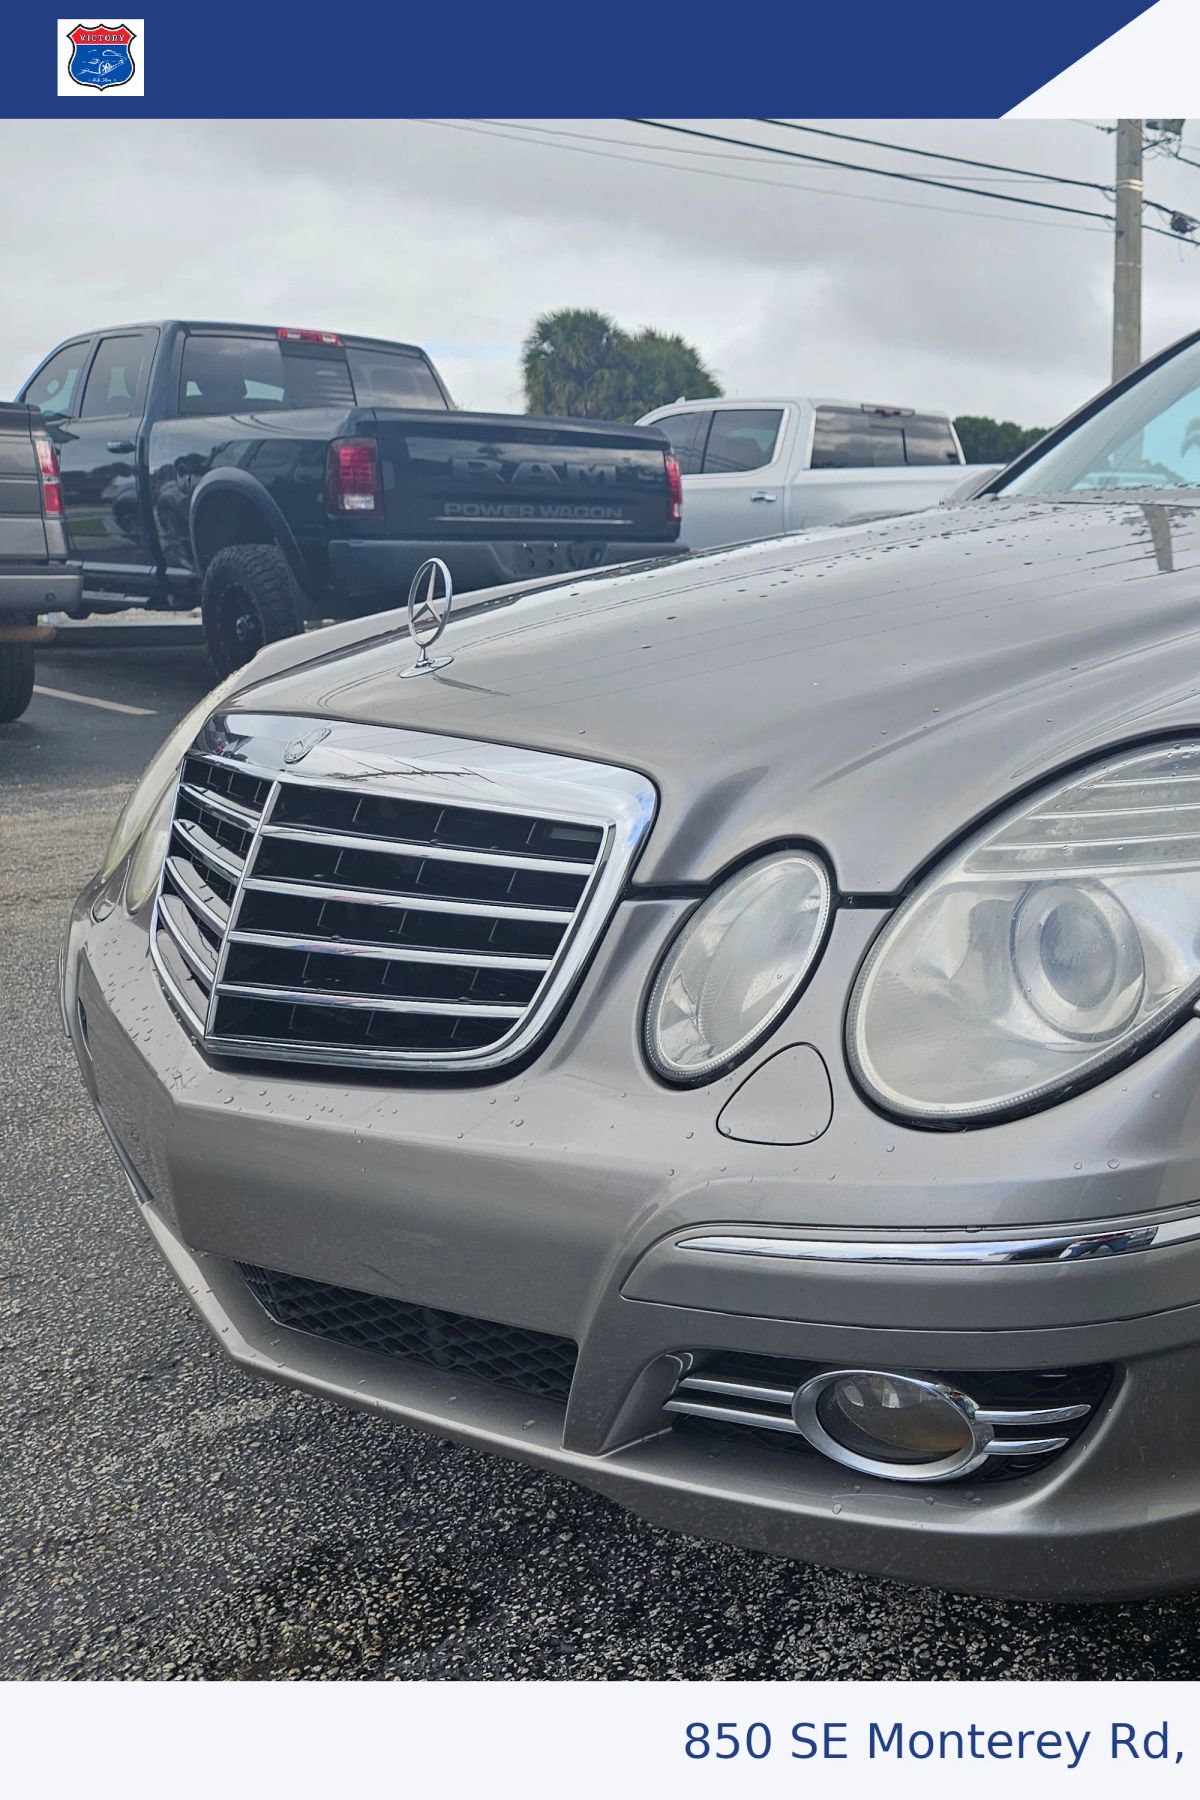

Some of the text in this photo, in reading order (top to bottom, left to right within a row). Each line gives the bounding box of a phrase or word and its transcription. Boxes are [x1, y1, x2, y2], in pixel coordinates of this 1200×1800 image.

[450, 458, 617, 485] RAM
[444, 502, 622, 519] POWER WAGON
